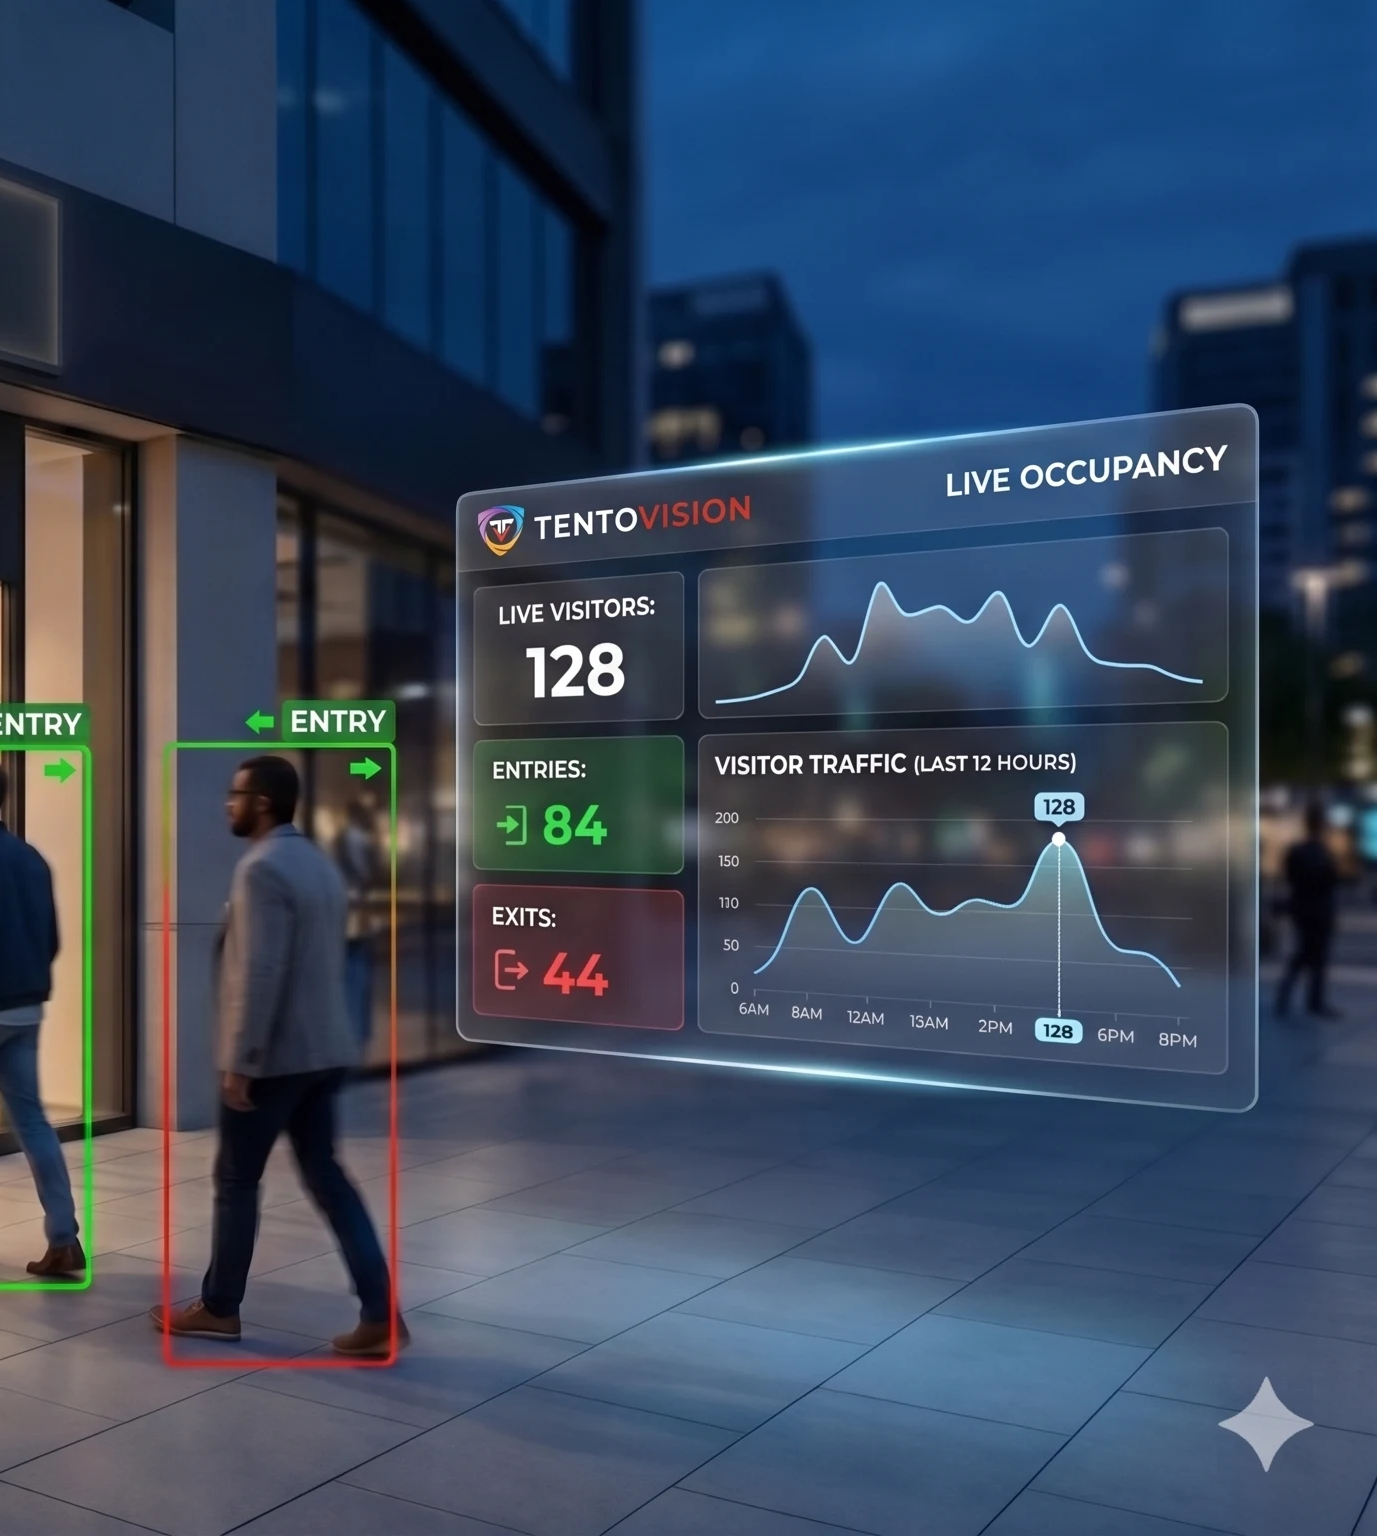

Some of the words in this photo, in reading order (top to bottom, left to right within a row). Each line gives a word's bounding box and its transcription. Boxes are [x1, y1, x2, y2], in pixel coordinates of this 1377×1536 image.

[946, 467, 1011, 497] LIVE
[1020, 444, 1229, 490] OCCUPANCY
[534, 495, 752, 540] TENTOVISION
[499, 603, 544, 625] LIVE
[550, 596, 656, 622] VISITORS:
[526, 642, 625, 699] 128
[492, 759, 587, 780] ENTRIES:
[715, 755, 803, 775] VISITOR
[809, 753, 907, 774] TRAFFIC
[913, 754, 968, 777] (LAST
[973, 754, 992, 772] 12
[997, 752, 1077, 775] HOURS)
[715, 811, 739, 824] 200
[1043, 799, 1075, 816] 128
[543, 804, 608, 846] 84
[718, 855, 739, 867] 150
[492, 907, 557, 927] EXITS:
[723, 939, 739, 951] 50
[543, 952, 609, 996] 44
[730, 982, 739, 995] 0
[739, 1002, 770, 1017] 6AM
[791, 1006, 823, 1021] 8AM
[847, 1010, 885, 1026] 12AM
[978, 1019, 1013, 1036] 2PM
[1043, 1024, 1074, 1040] 128
[1097, 1028, 1135, 1044] 6PM
[1158, 1032, 1198, 1049] 8PM
